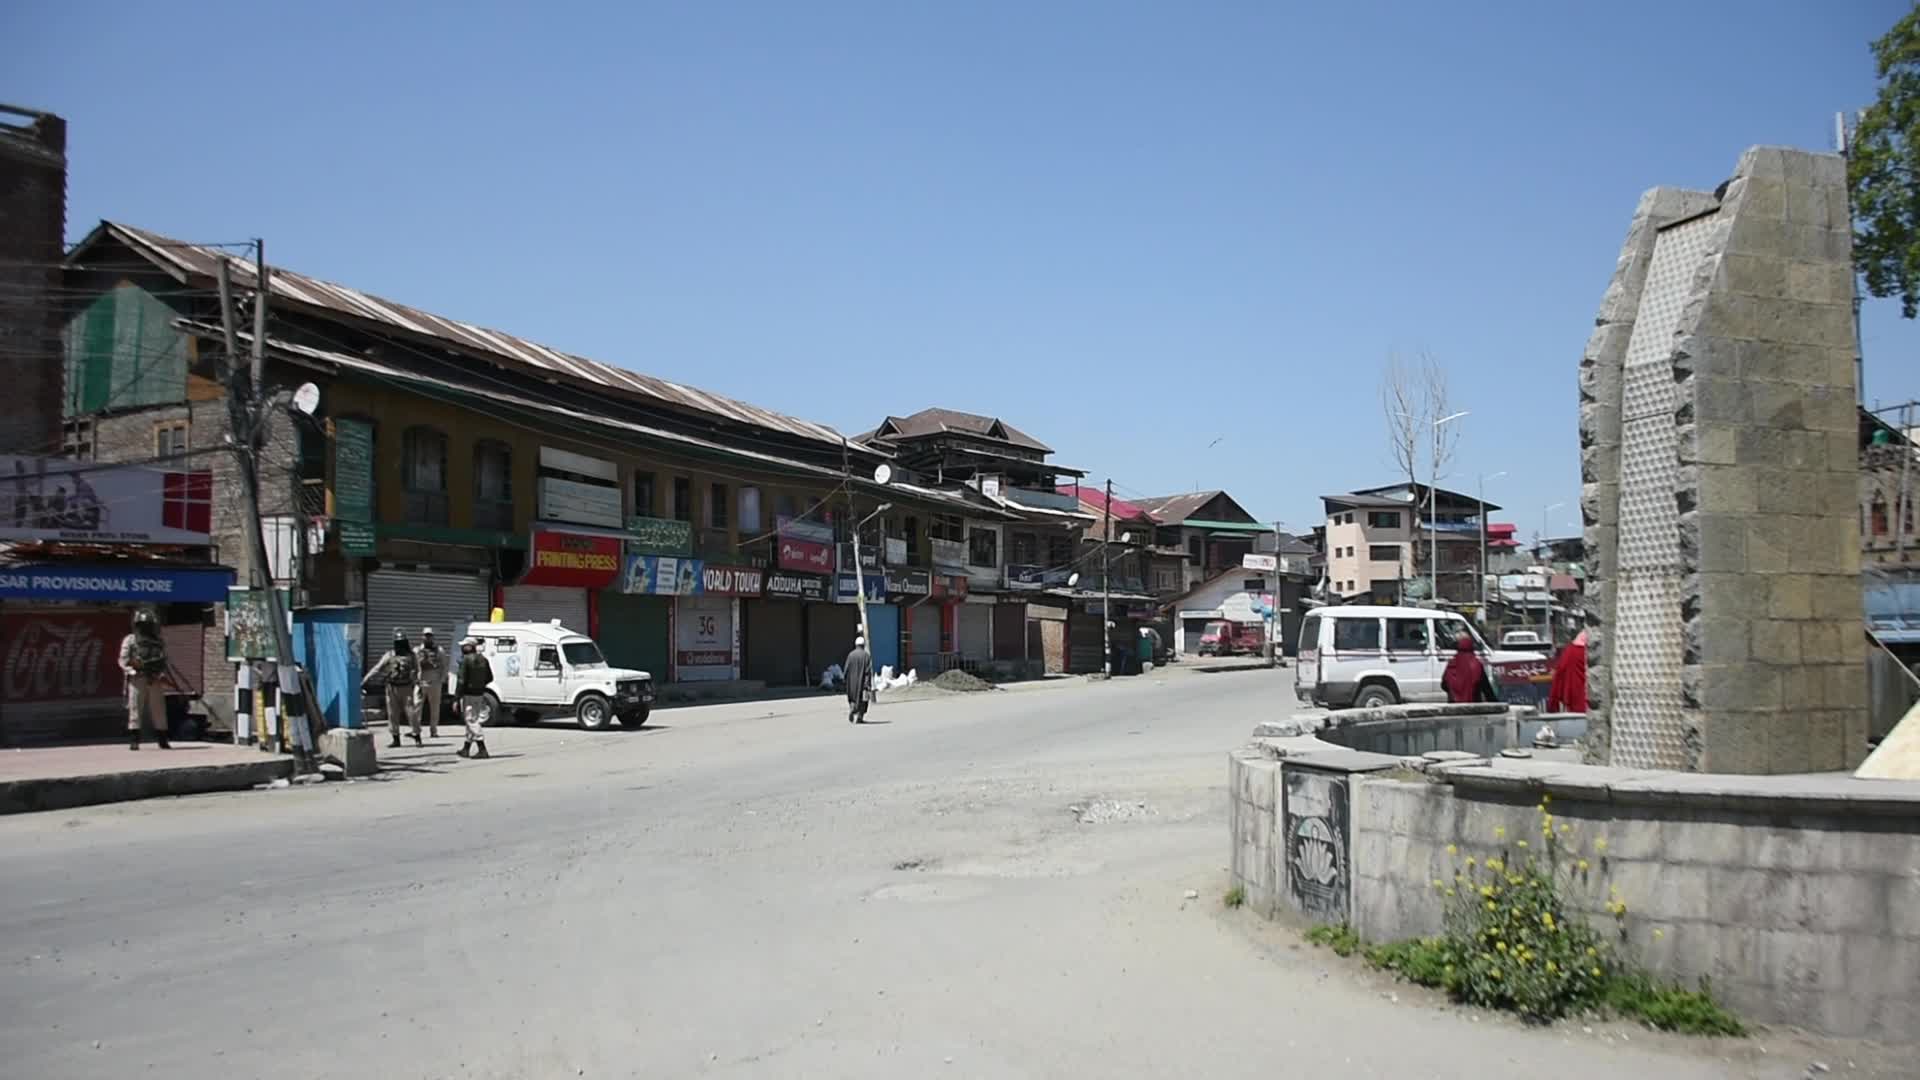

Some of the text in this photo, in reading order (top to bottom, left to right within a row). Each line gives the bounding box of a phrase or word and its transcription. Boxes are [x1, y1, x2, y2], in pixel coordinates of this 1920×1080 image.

[584, 553, 617, 570] PRESS
[33, 576, 129, 592] PROVISIONAL
[132, 578, 173, 593] STORE
[734, 570, 761, 593] TOUCH
[699, 616, 715, 636] 3G
